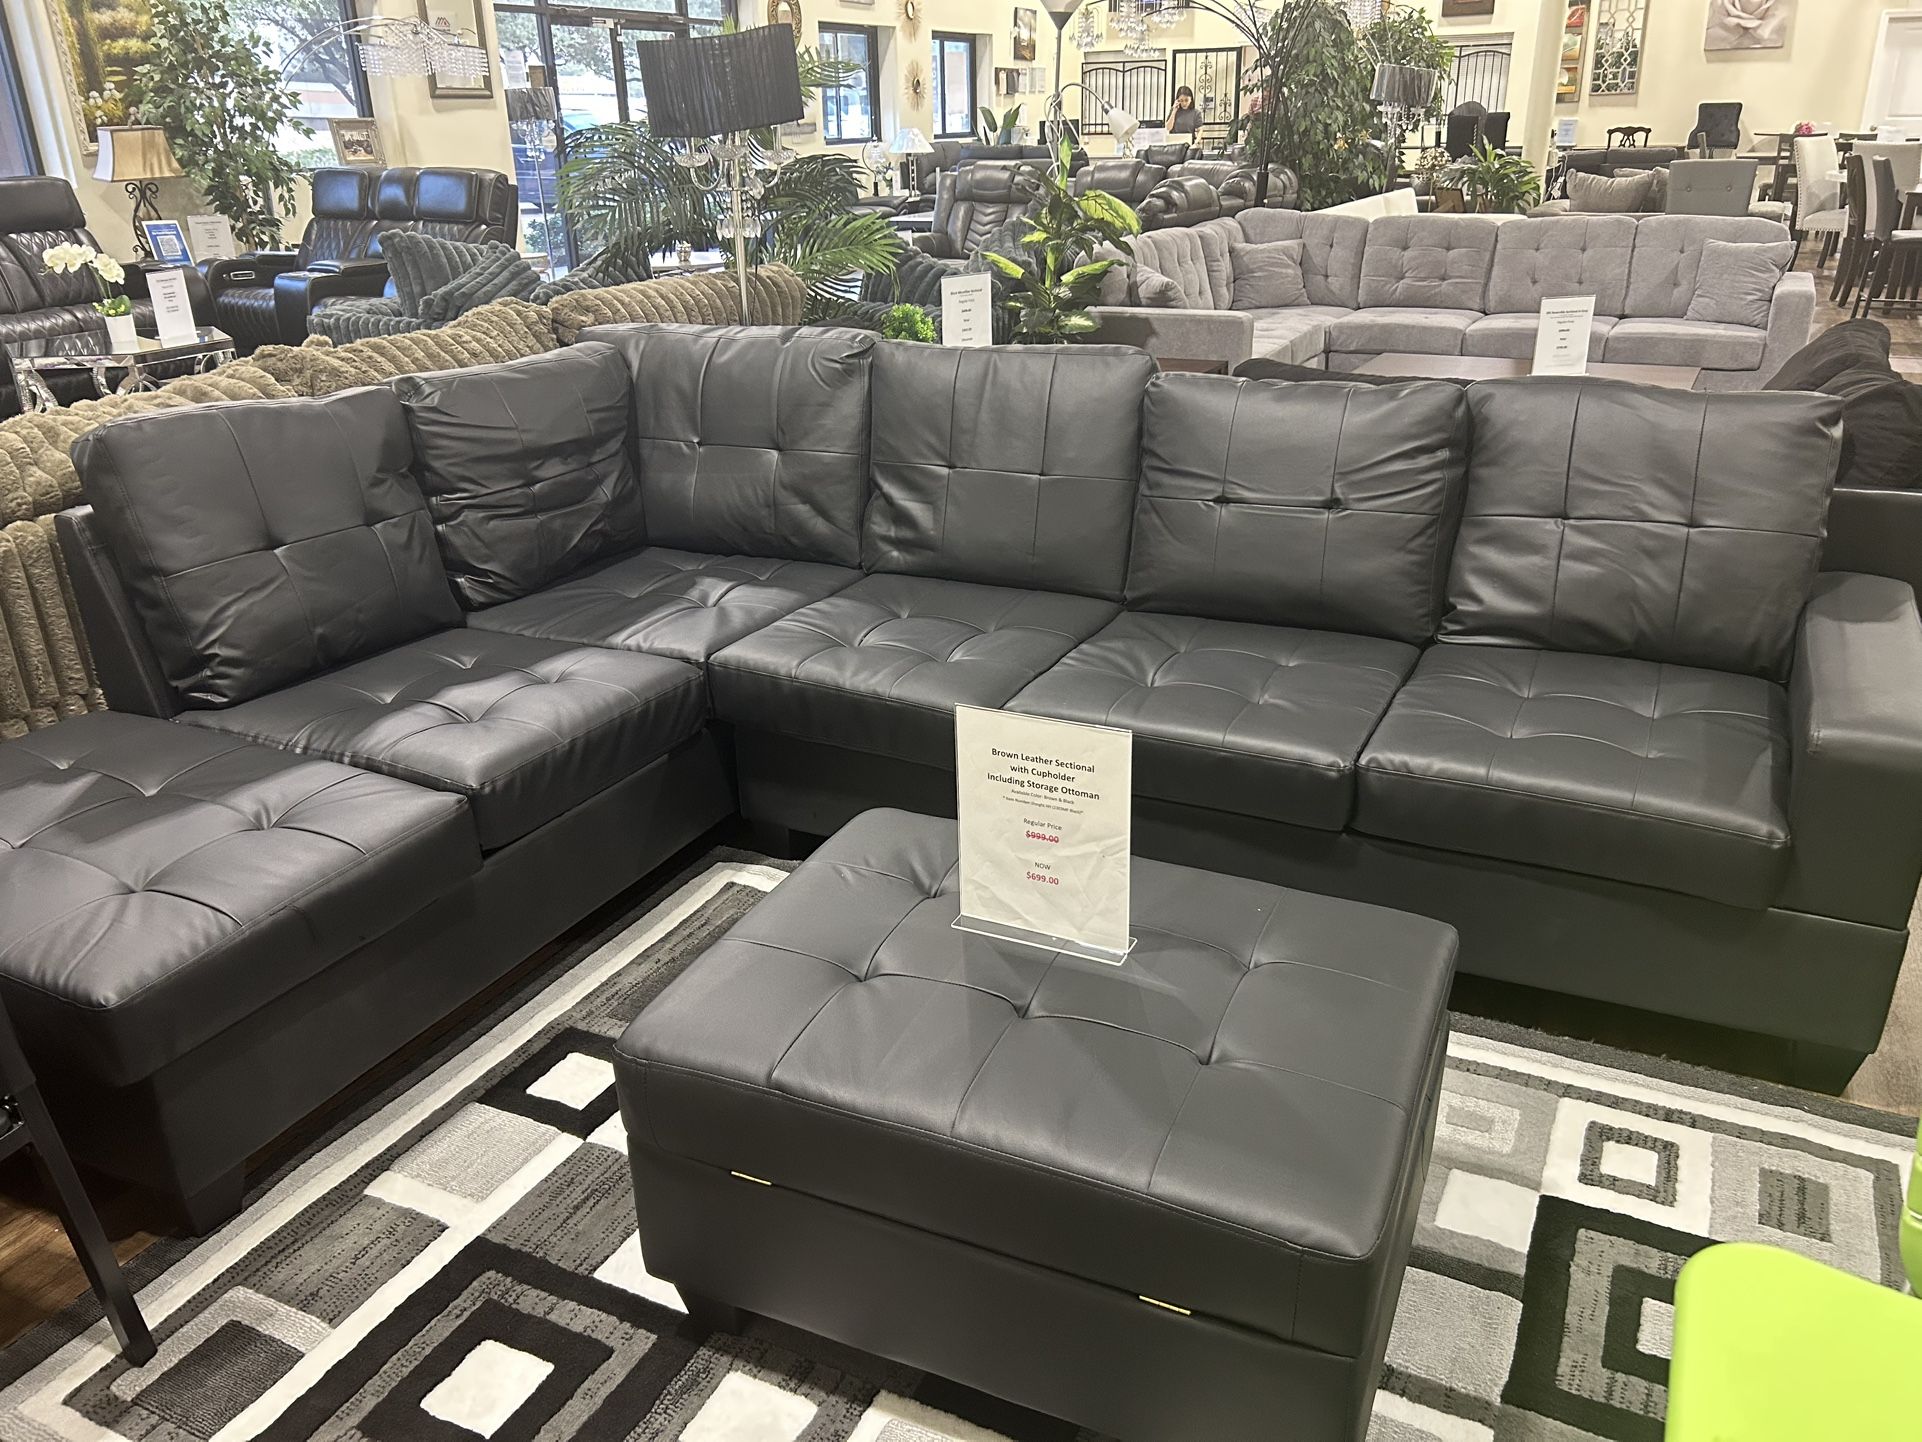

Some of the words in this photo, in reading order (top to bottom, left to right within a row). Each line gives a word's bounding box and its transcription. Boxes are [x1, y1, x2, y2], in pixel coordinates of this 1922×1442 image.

[991, 747, 1019, 760] Brown
[1021, 753, 1053, 766] Leather
[1055, 759, 1095, 773] Sectional
[1010, 765, 1029, 774] with
[1031, 768, 1075, 782] Cupholder
[987, 773, 1025, 788] Including
[1027, 780, 1059, 793] Storage
[1061, 786, 1100, 800] Ottoman
[1023, 818, 1046, 827] Regular
[1047, 822, 1062, 831] Price
[1025, 830, 1059, 843] $999.00
[1034, 862, 1051, 870] NOW
[1026, 871, 1059, 885] $699.00
